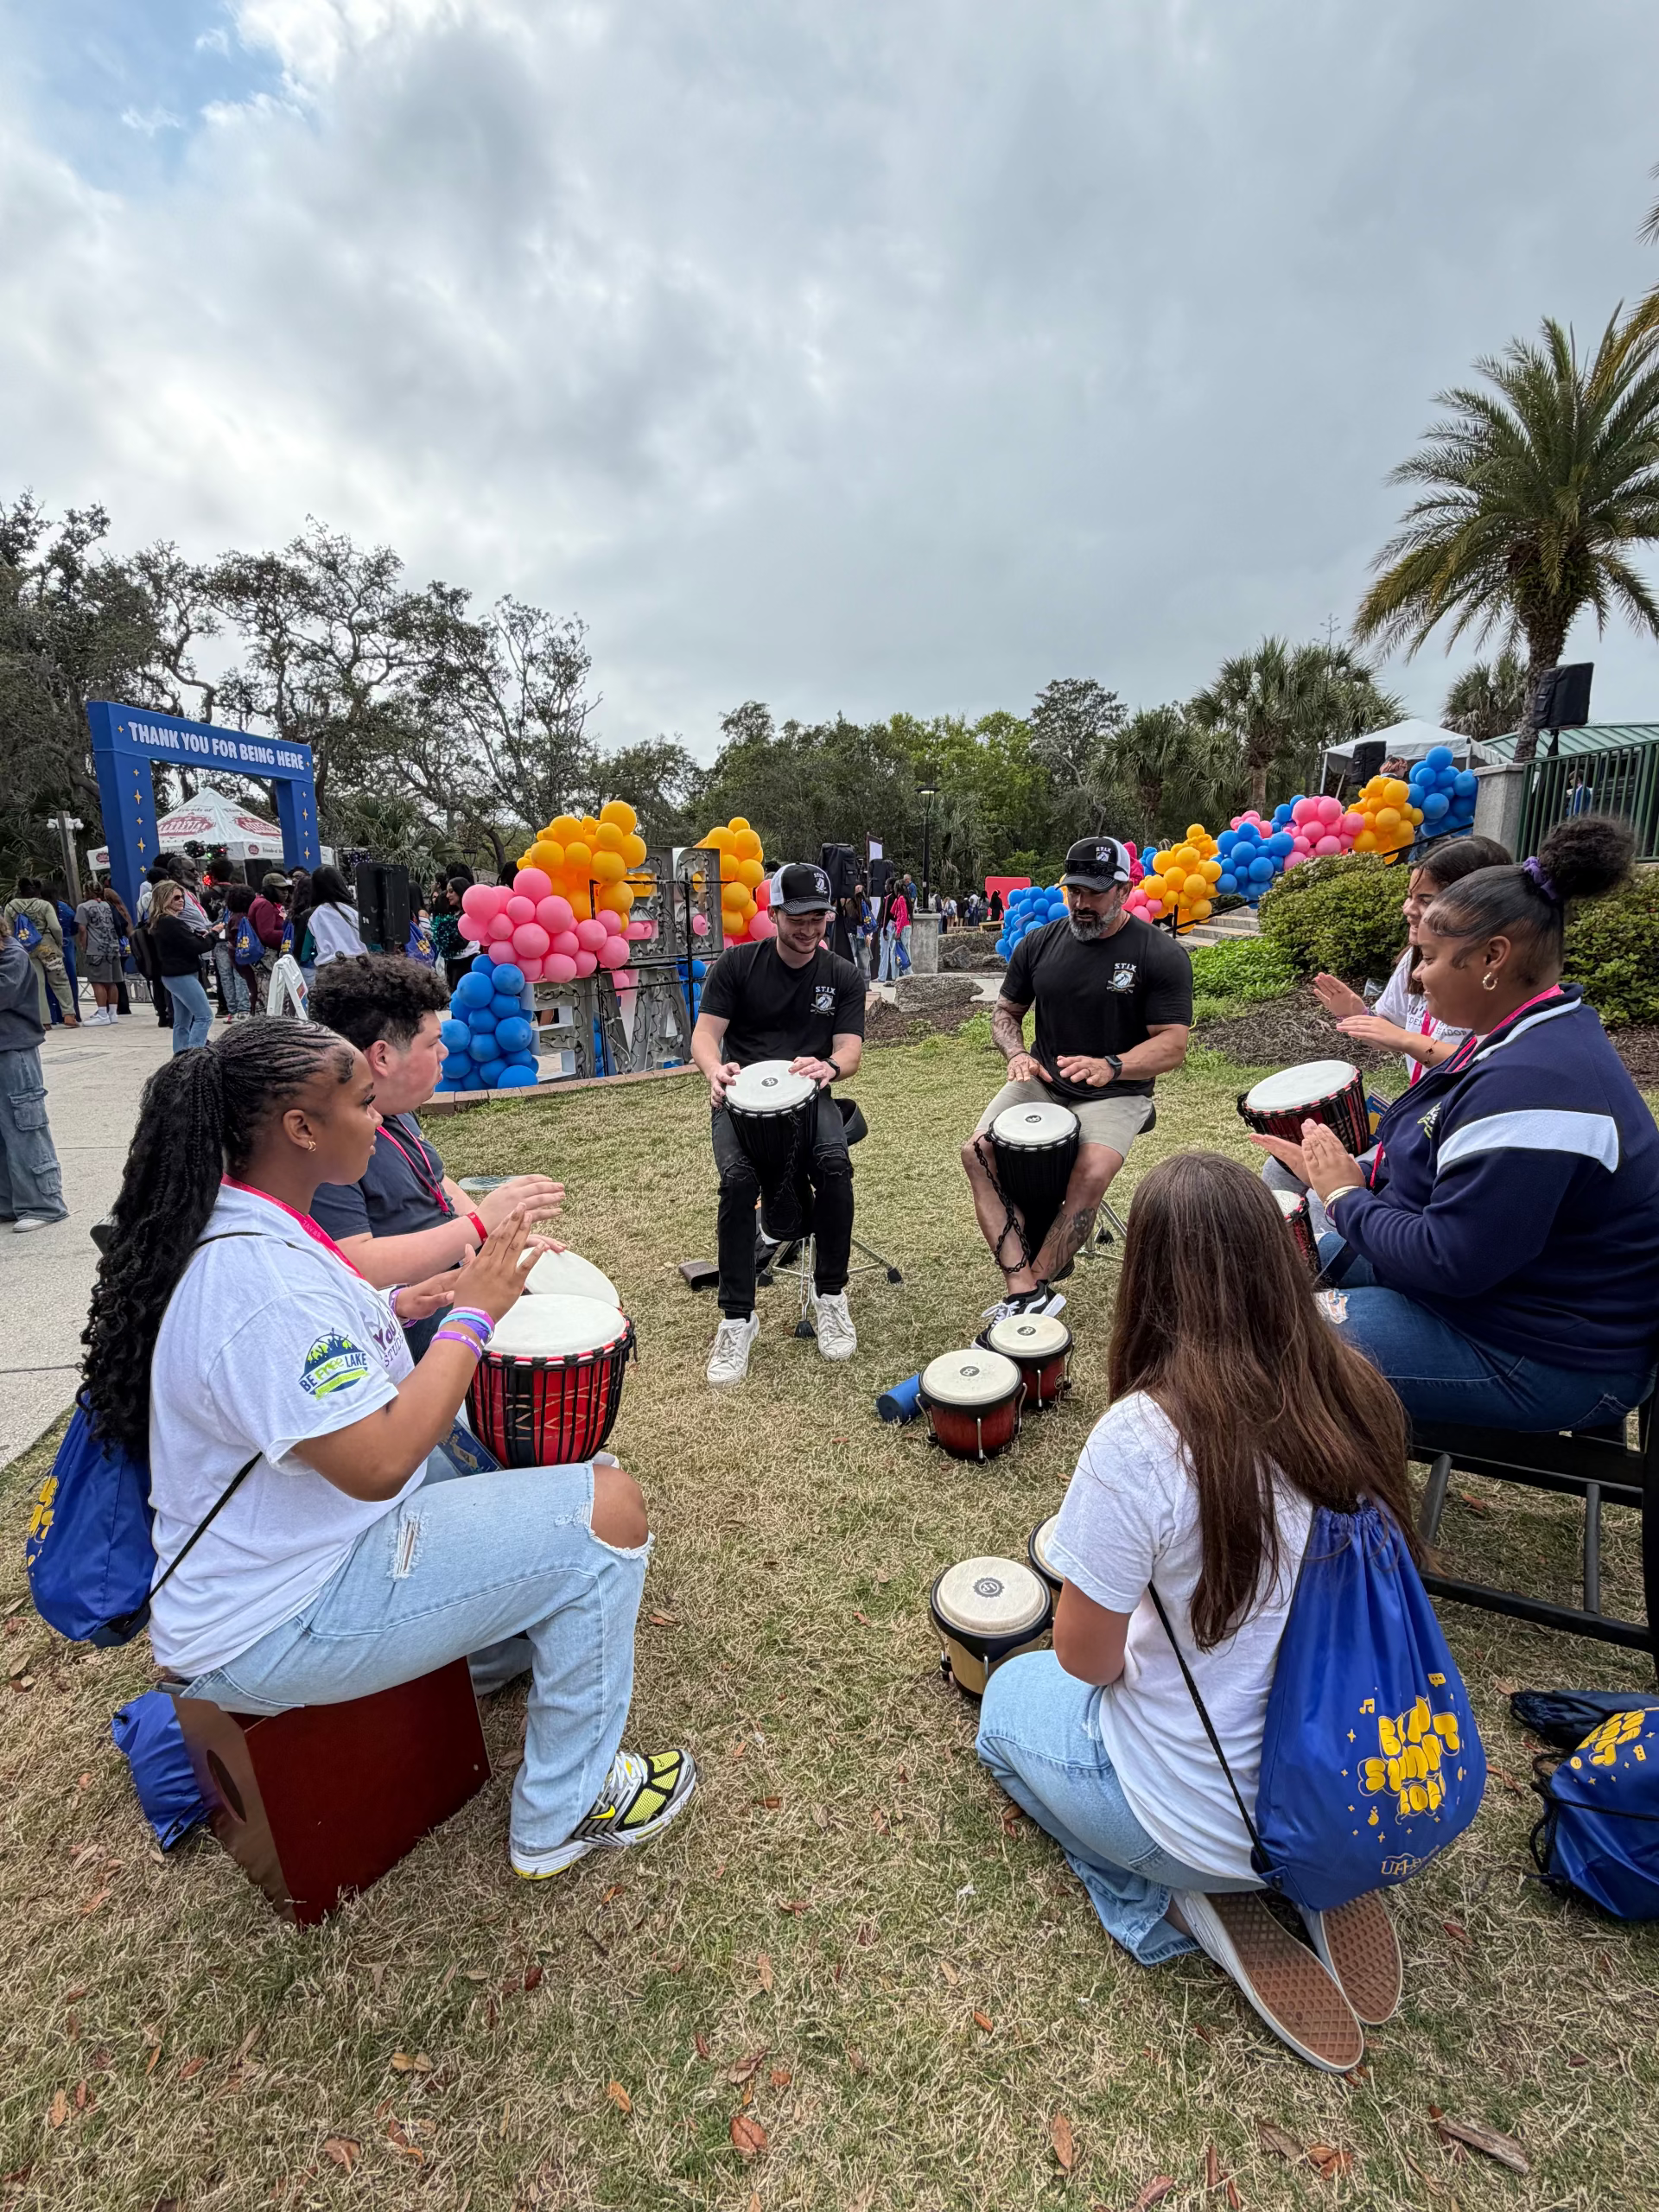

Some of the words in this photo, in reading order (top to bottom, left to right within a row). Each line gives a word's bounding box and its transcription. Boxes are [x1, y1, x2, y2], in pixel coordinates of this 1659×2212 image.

[127, 721, 181, 749] THANK
[180, 732, 209, 754] YOU
[212, 738, 238, 759] FOR
[239, 743, 275, 766] BEING
[276, 749, 305, 771] HERE
[299, 1374, 318, 1393] BE
[345, 1353, 367, 1368] LAKE
